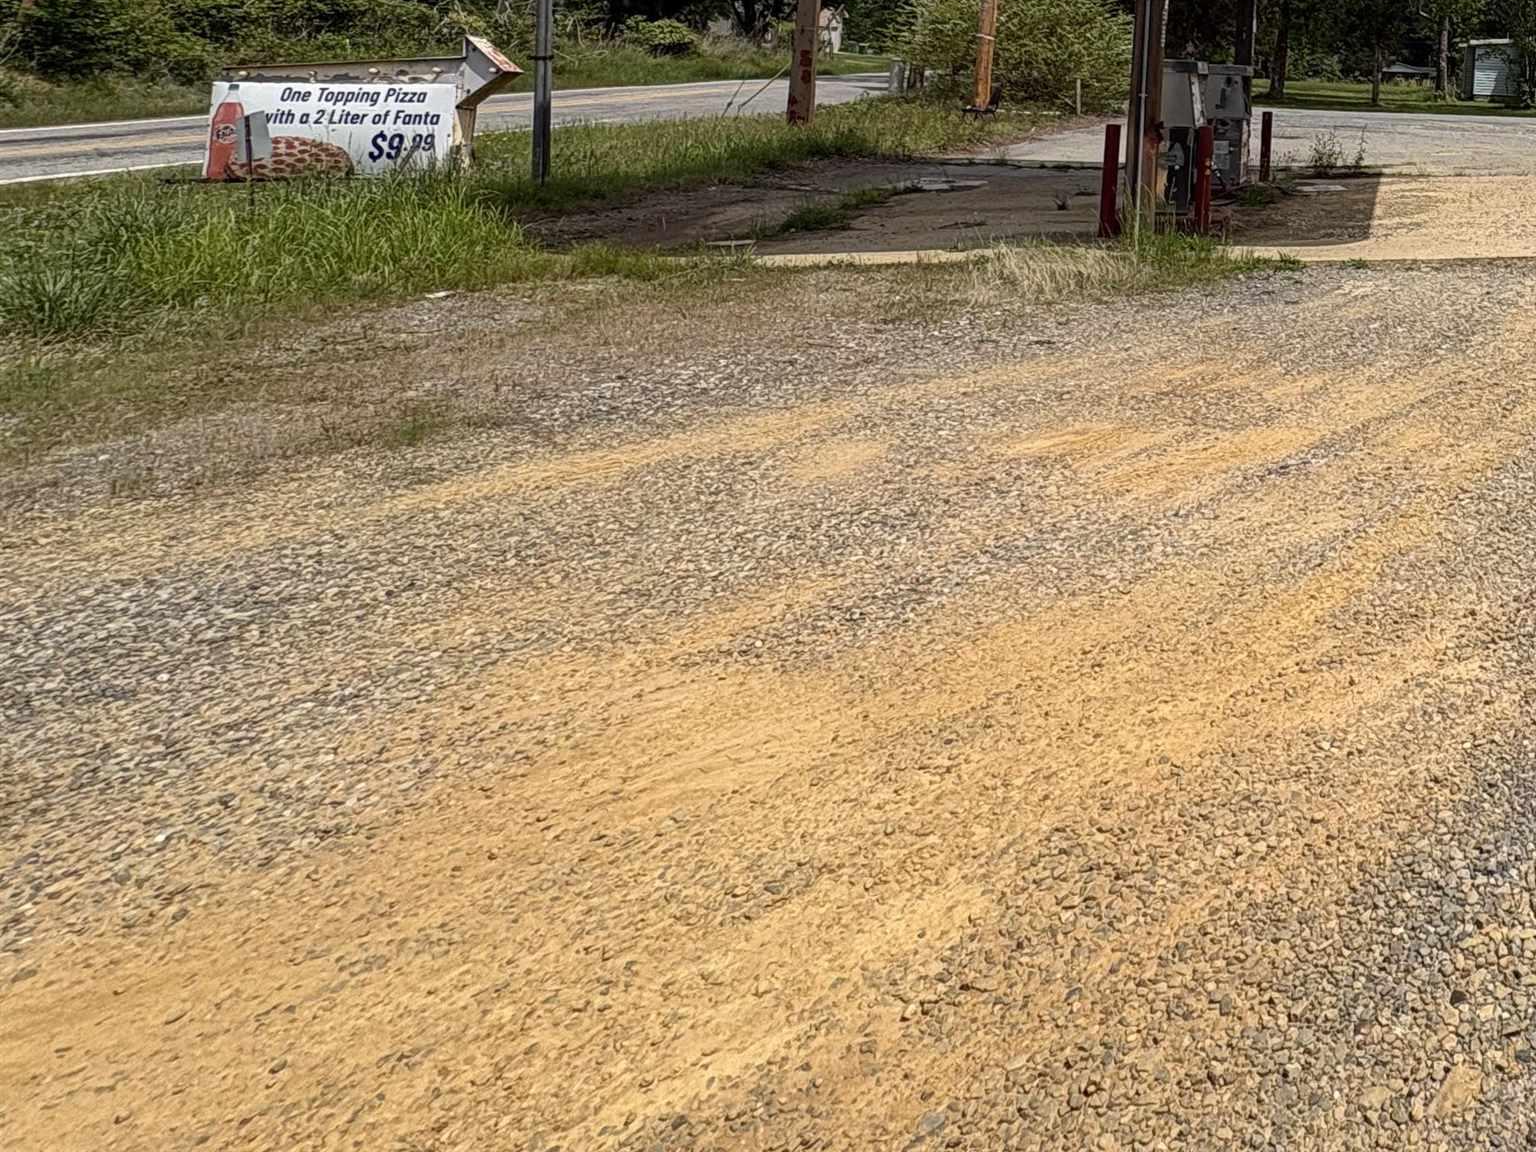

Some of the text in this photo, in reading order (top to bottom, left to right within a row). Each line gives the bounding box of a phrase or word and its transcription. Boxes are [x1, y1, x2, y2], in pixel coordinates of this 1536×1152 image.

[280, 87, 428, 106] One Topping Pizza
[299, 112, 310, 124] a
[312, 109, 326, 124] 2
[328, 109, 369, 125] Liter
[372, 109, 391, 125] of
[393, 110, 441, 125] Fanta
